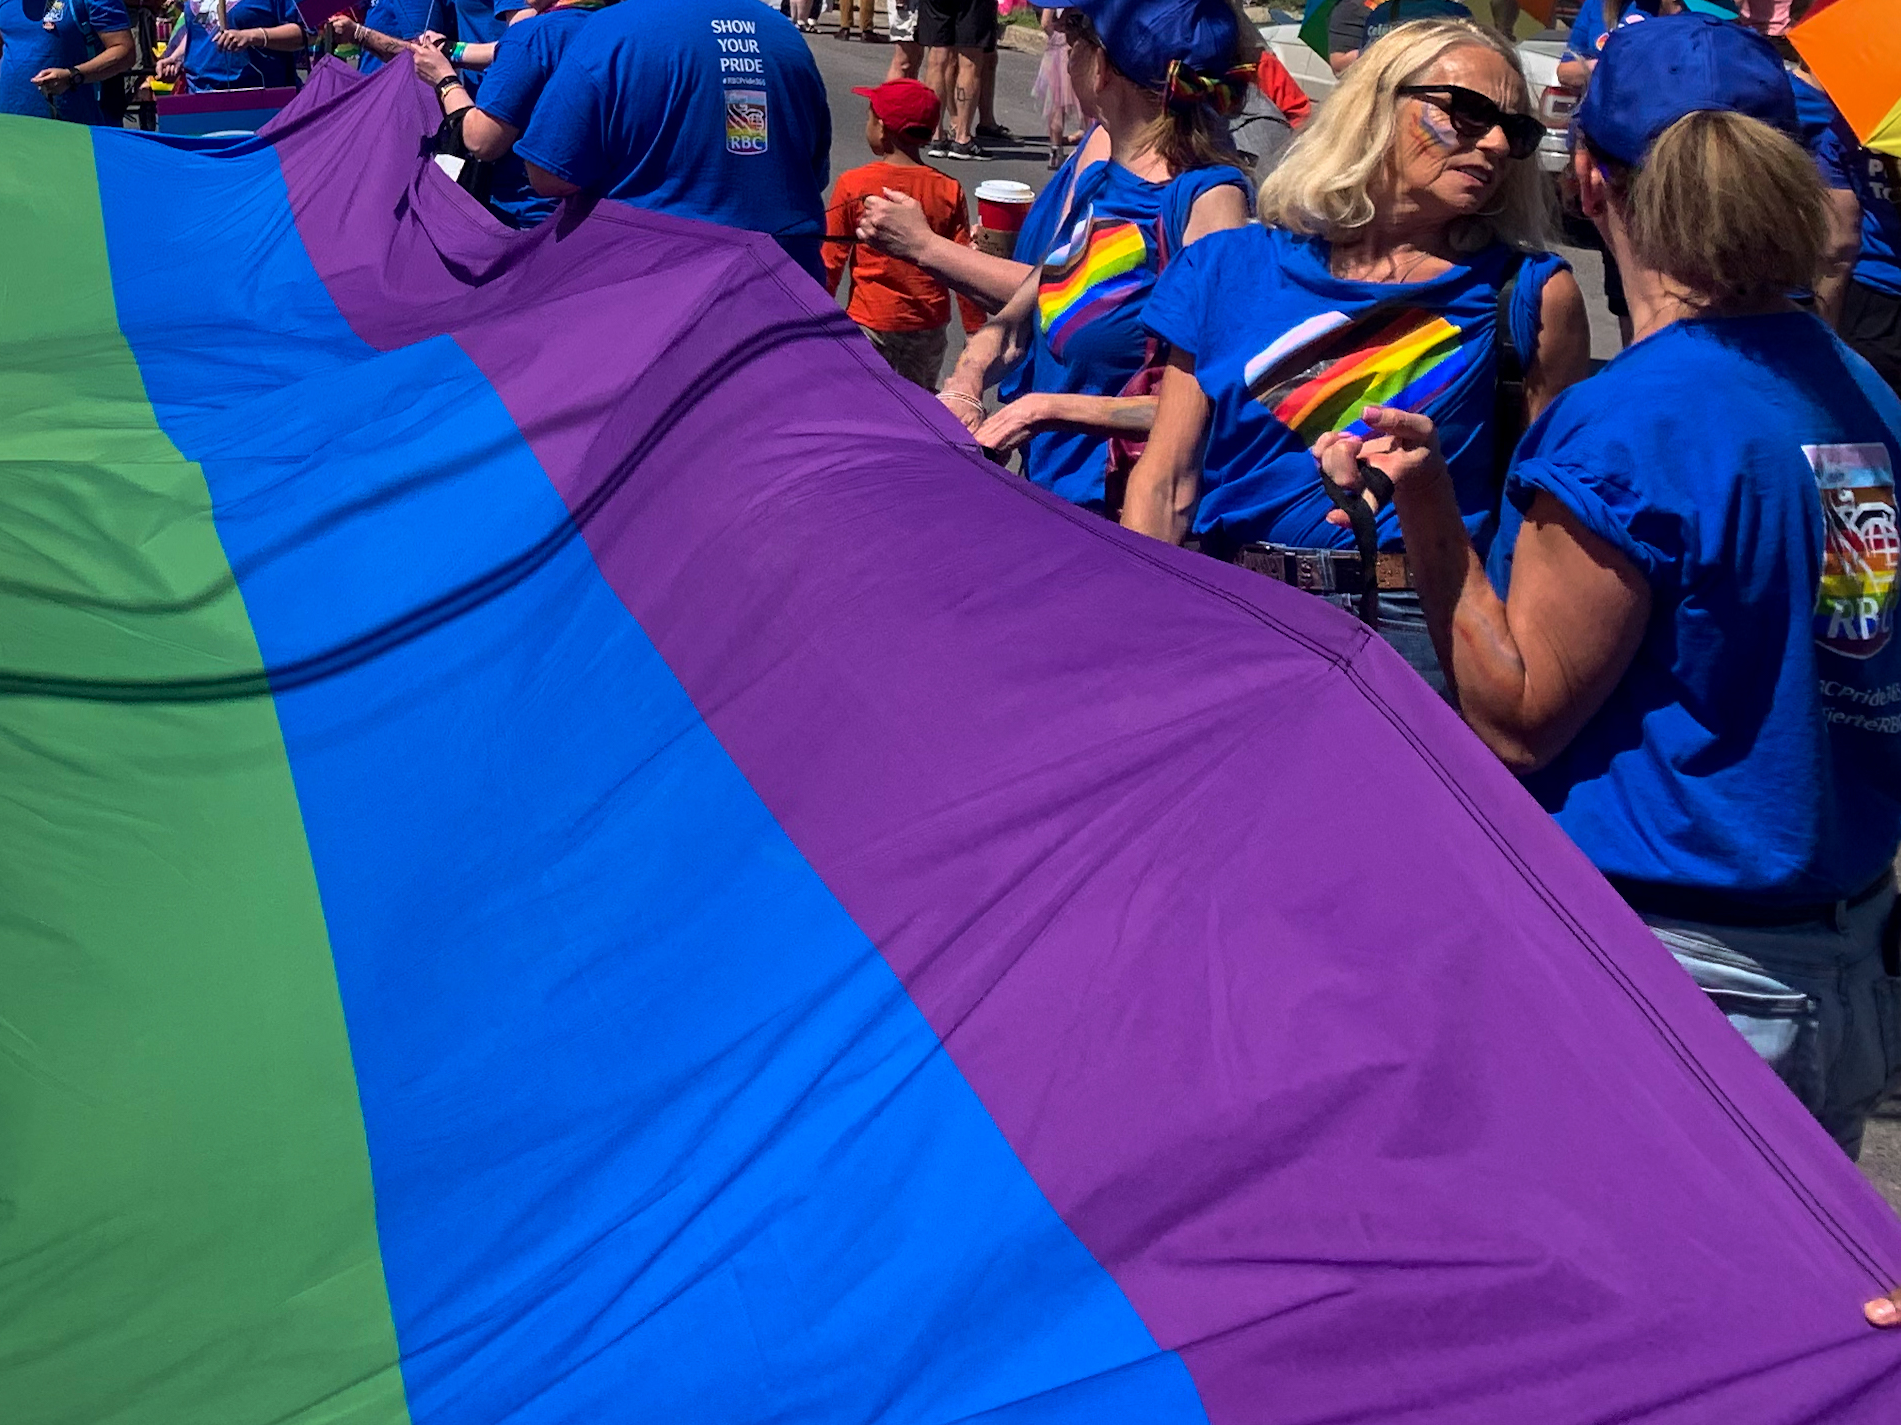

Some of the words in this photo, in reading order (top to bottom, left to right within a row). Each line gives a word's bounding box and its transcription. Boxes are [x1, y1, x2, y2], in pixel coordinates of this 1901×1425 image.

[711, 19, 756, 34] SHOW
[717, 38, 760, 54] YOUR
[720, 58, 765, 74] PRIDE
[731, 135, 763, 150] RBC
